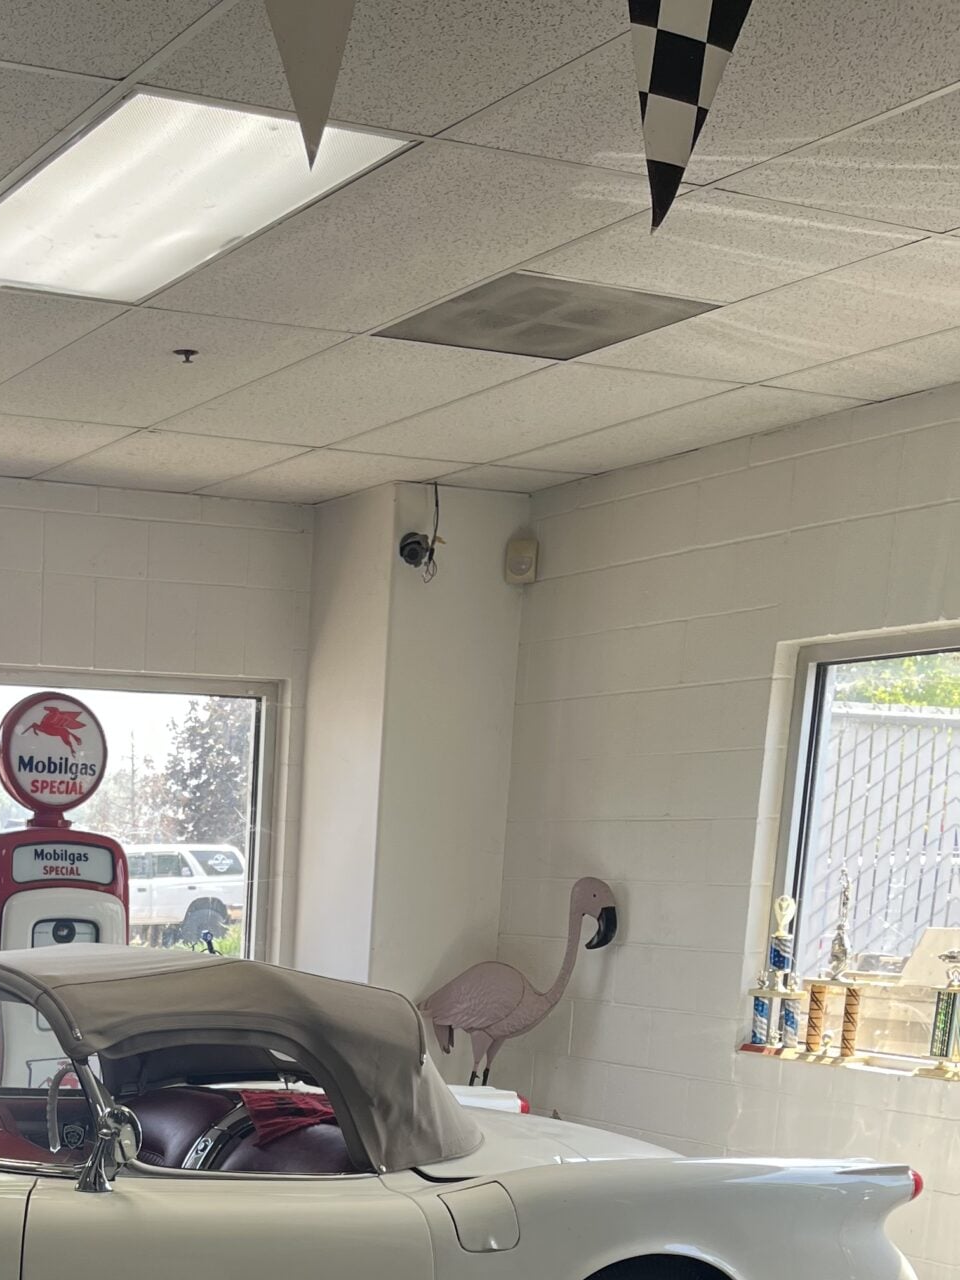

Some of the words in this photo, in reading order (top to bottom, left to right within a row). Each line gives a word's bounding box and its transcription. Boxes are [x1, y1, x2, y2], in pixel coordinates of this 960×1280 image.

[17, 755, 96, 780] Mobilgas
[30, 780, 85, 795] SPECIAL
[34, 849, 88, 865] Mobilgas
[43, 866, 81, 876] SPECIAL
